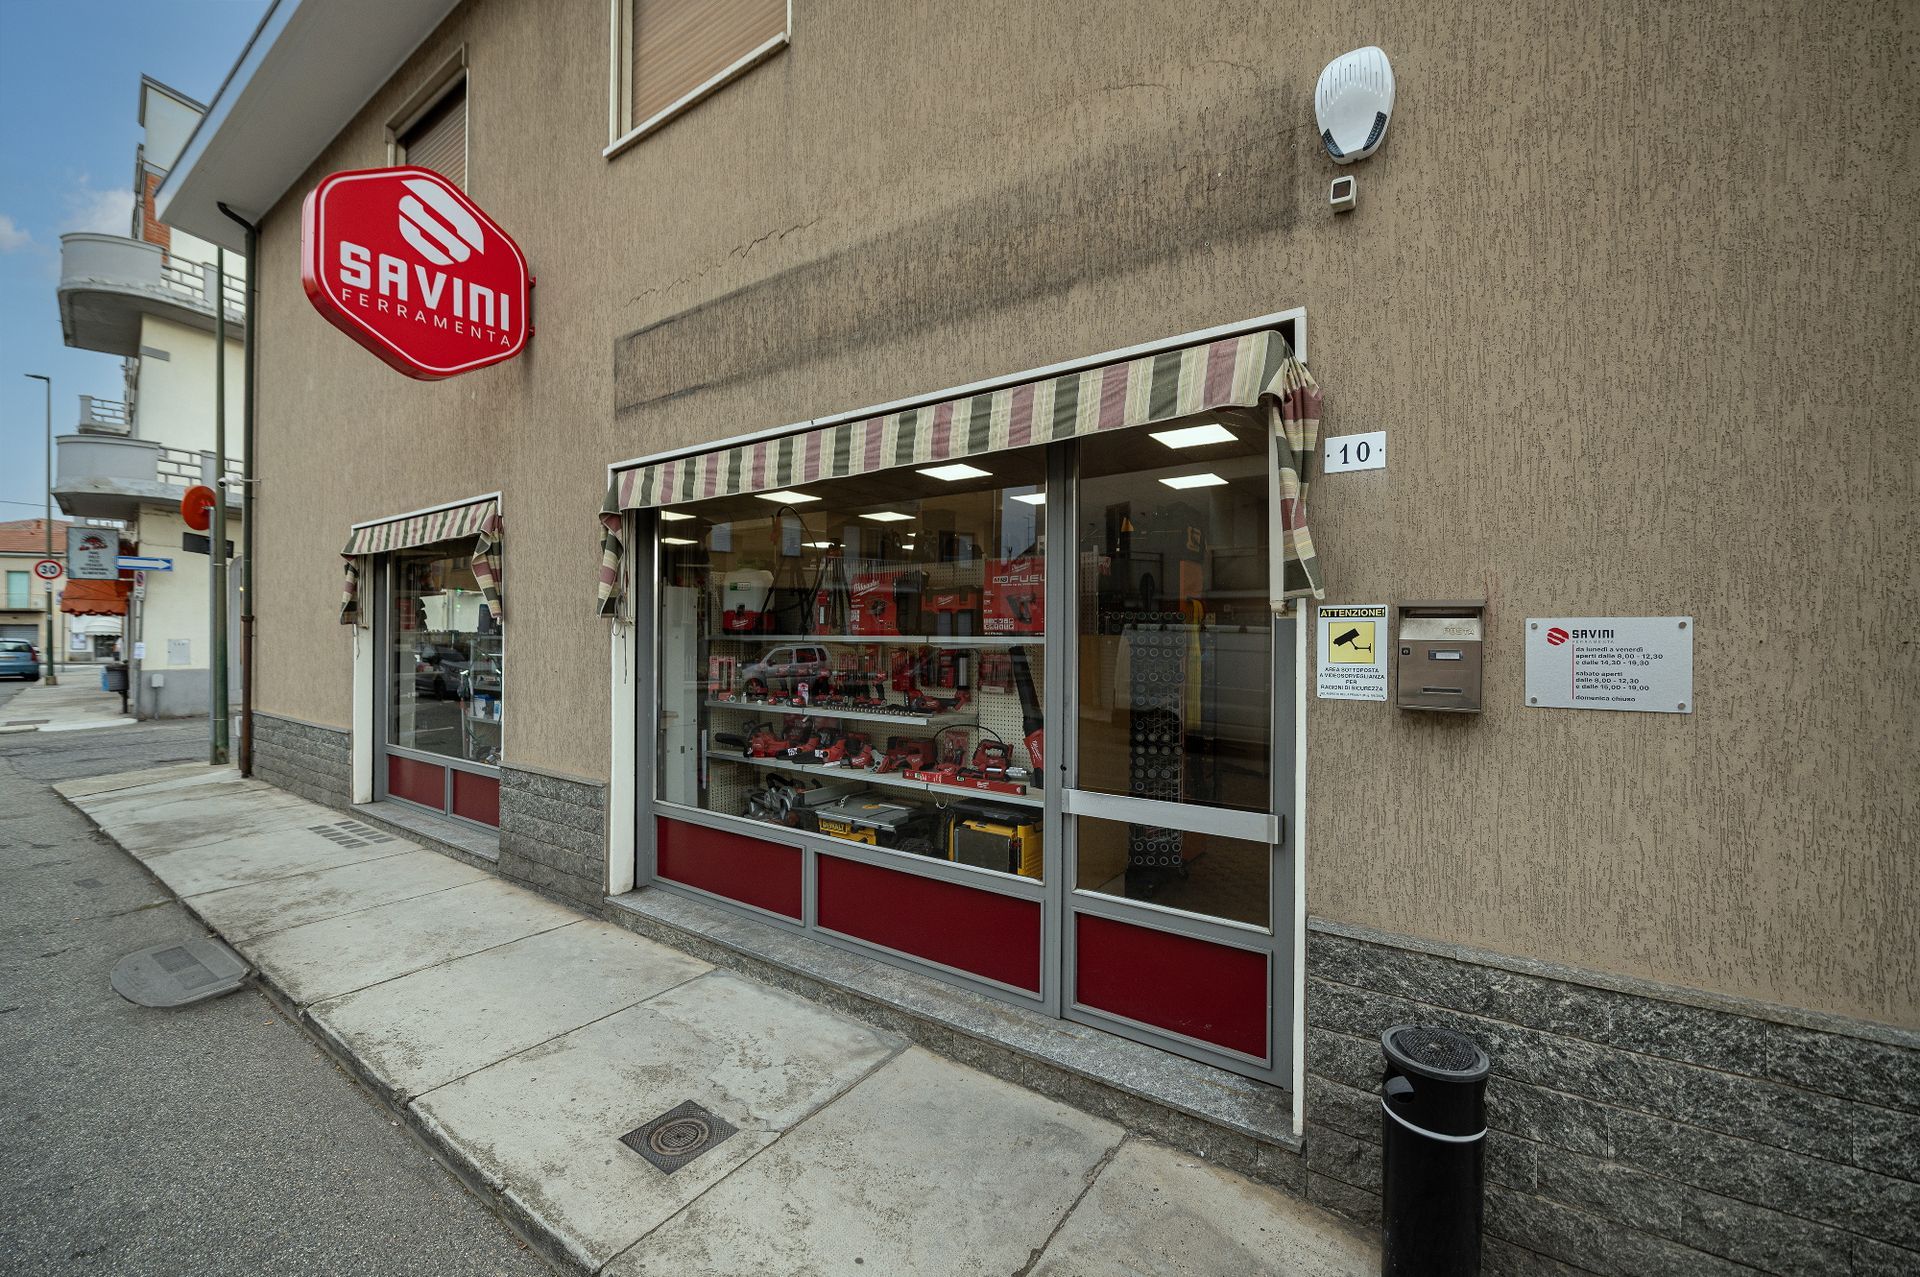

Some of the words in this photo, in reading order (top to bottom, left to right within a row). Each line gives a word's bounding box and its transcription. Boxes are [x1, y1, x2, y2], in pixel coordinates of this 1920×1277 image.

[340, 241, 510, 332] SAVINI
[342, 288, 511, 347] FERRAMENTA
[1340, 441, 1370, 464] 10
[40, 564, 57, 575] 30
[1320, 608, 1385, 617] ATTENZIONE!
[1572, 629, 1614, 638] SAVINI
